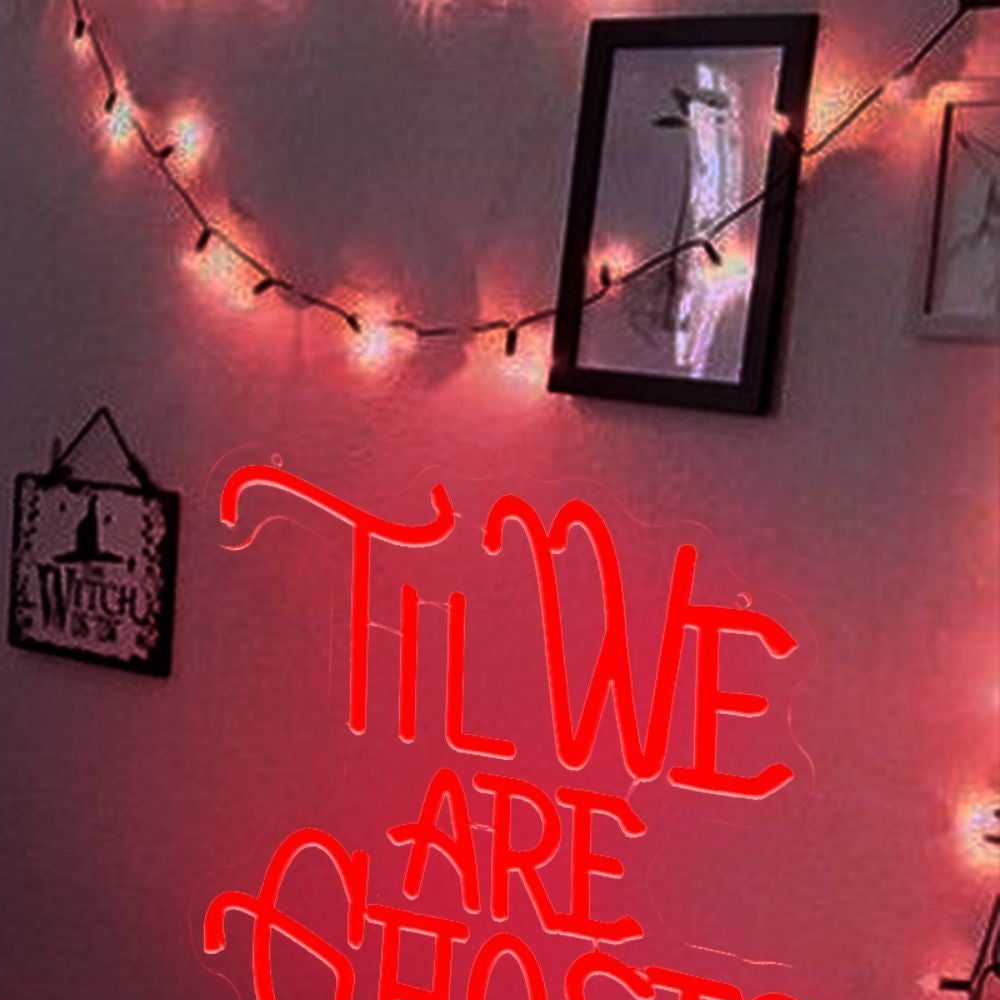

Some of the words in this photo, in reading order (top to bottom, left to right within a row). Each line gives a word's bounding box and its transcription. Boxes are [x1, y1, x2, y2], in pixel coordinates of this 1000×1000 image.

[220, 464, 517, 760] TIL
[482, 493, 798, 800] WE
[387, 766, 647, 943] ARE
